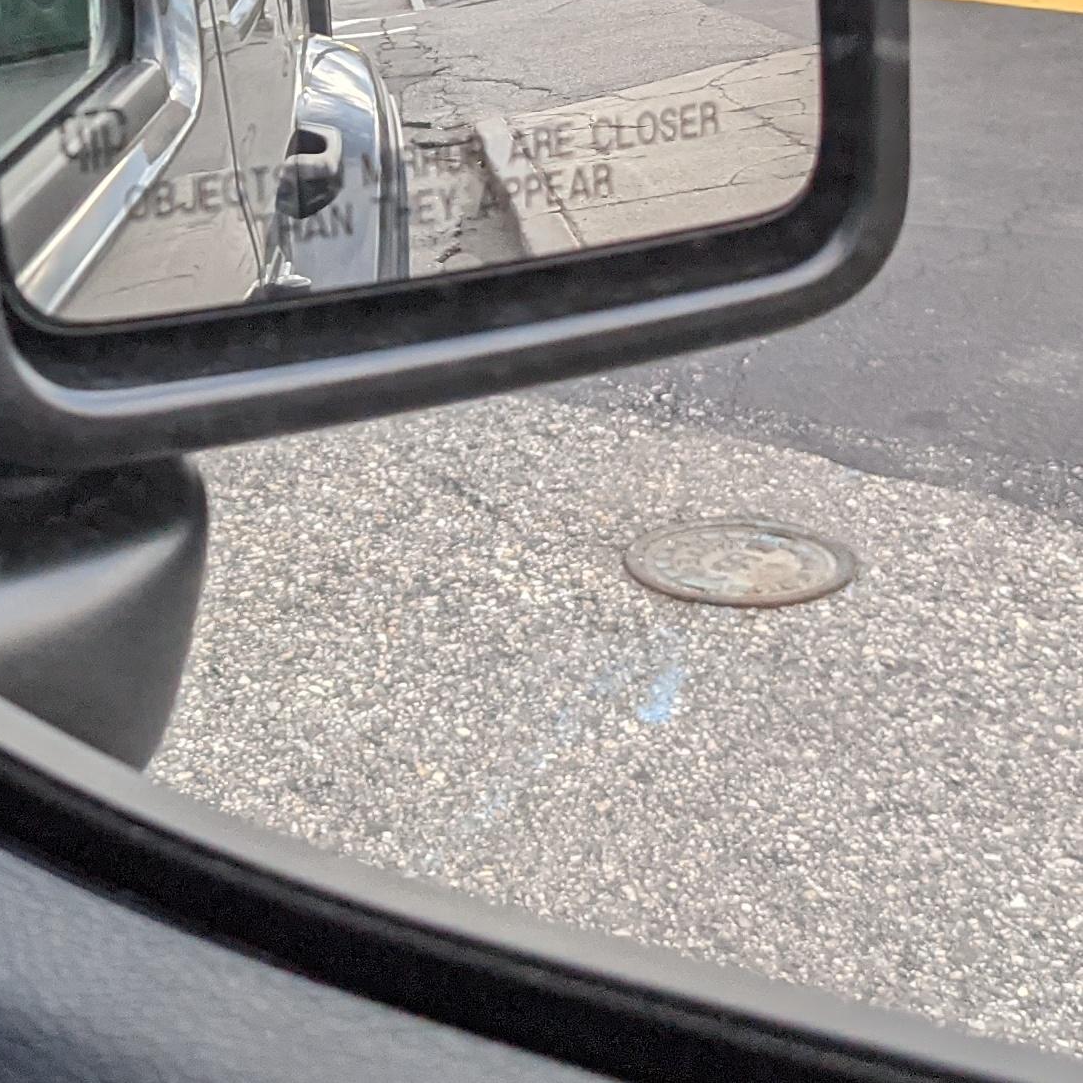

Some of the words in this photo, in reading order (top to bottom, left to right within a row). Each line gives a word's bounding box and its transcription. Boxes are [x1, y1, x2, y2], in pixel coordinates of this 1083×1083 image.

[125, 164, 294, 218] OBJECT
[508, 122, 573, 164] ARE
[591, 100, 720, 155] CLOSER
